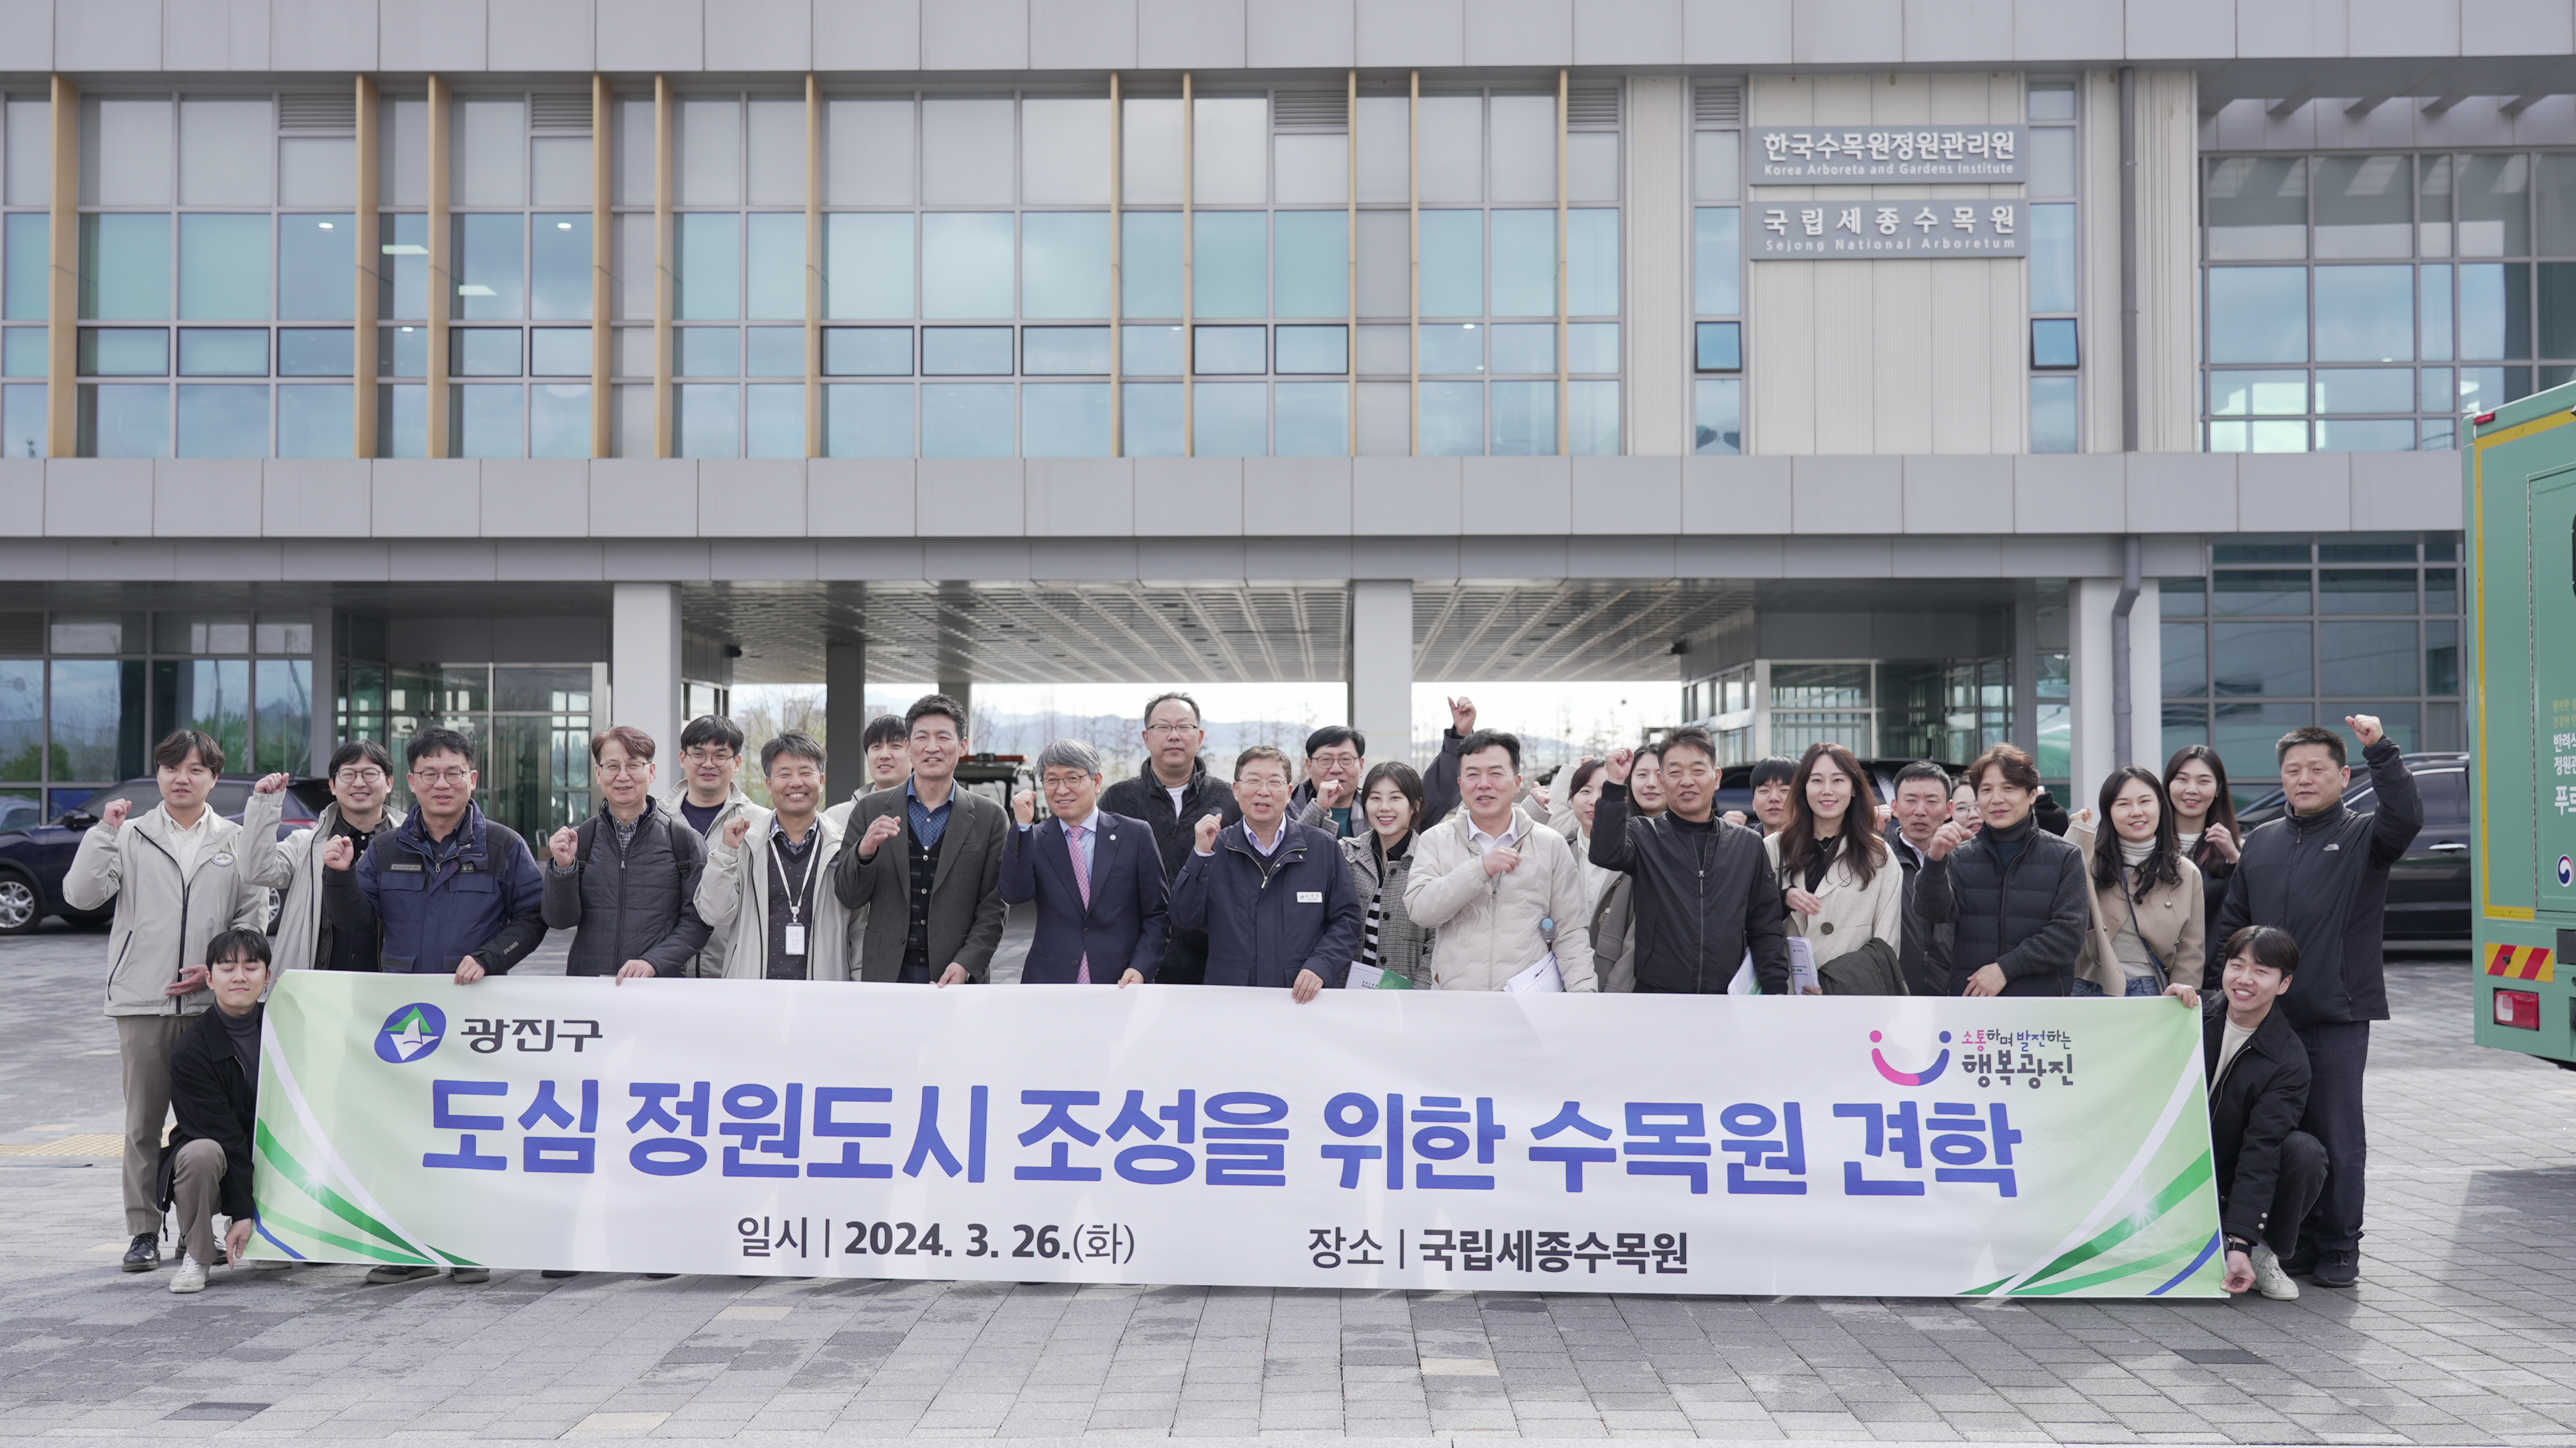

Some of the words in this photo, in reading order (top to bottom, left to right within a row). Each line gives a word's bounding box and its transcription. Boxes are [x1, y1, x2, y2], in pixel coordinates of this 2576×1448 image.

[1763, 131, 2014, 161] 한국수목원정원관리원
[1764, 165, 1802, 176] Korea
[1807, 164, 1865, 176] Arboreta
[1869, 163, 1894, 175] and
[1899, 163, 1953, 175] Gardens
[1958, 163, 2013, 174] Institute
[1766, 239, 1824, 253] Sejong
[1835, 237, 1911, 250] National
[1921, 237, 2015, 249] Arboretum
[461, 1019, 603, 1054] 광진구
[1962, 1029, 2012, 1052] 소통하며
[2016, 1030, 2071, 1052] 발전하는
[1962, 1050, 2074, 1089] 행복광진
[422, 1079, 599, 1174] 도심
[626, 1081, 988, 1183] 정원도시
[1014, 1089, 1289, 1186] 조성을
[1321, 1091, 1506, 1190] 위한
[1529, 1101, 1808, 1195] 수목원
[1832, 1100, 2023, 1198] 견학
[737, 1216, 807, 1258] 일시
[844, 1221, 952, 1258] 2024.
[965, 1223, 999, 1258] 3.
[1308, 1226, 1384, 1269] 장소
[1419, 1229, 1688, 1274] 국립세종수목원
